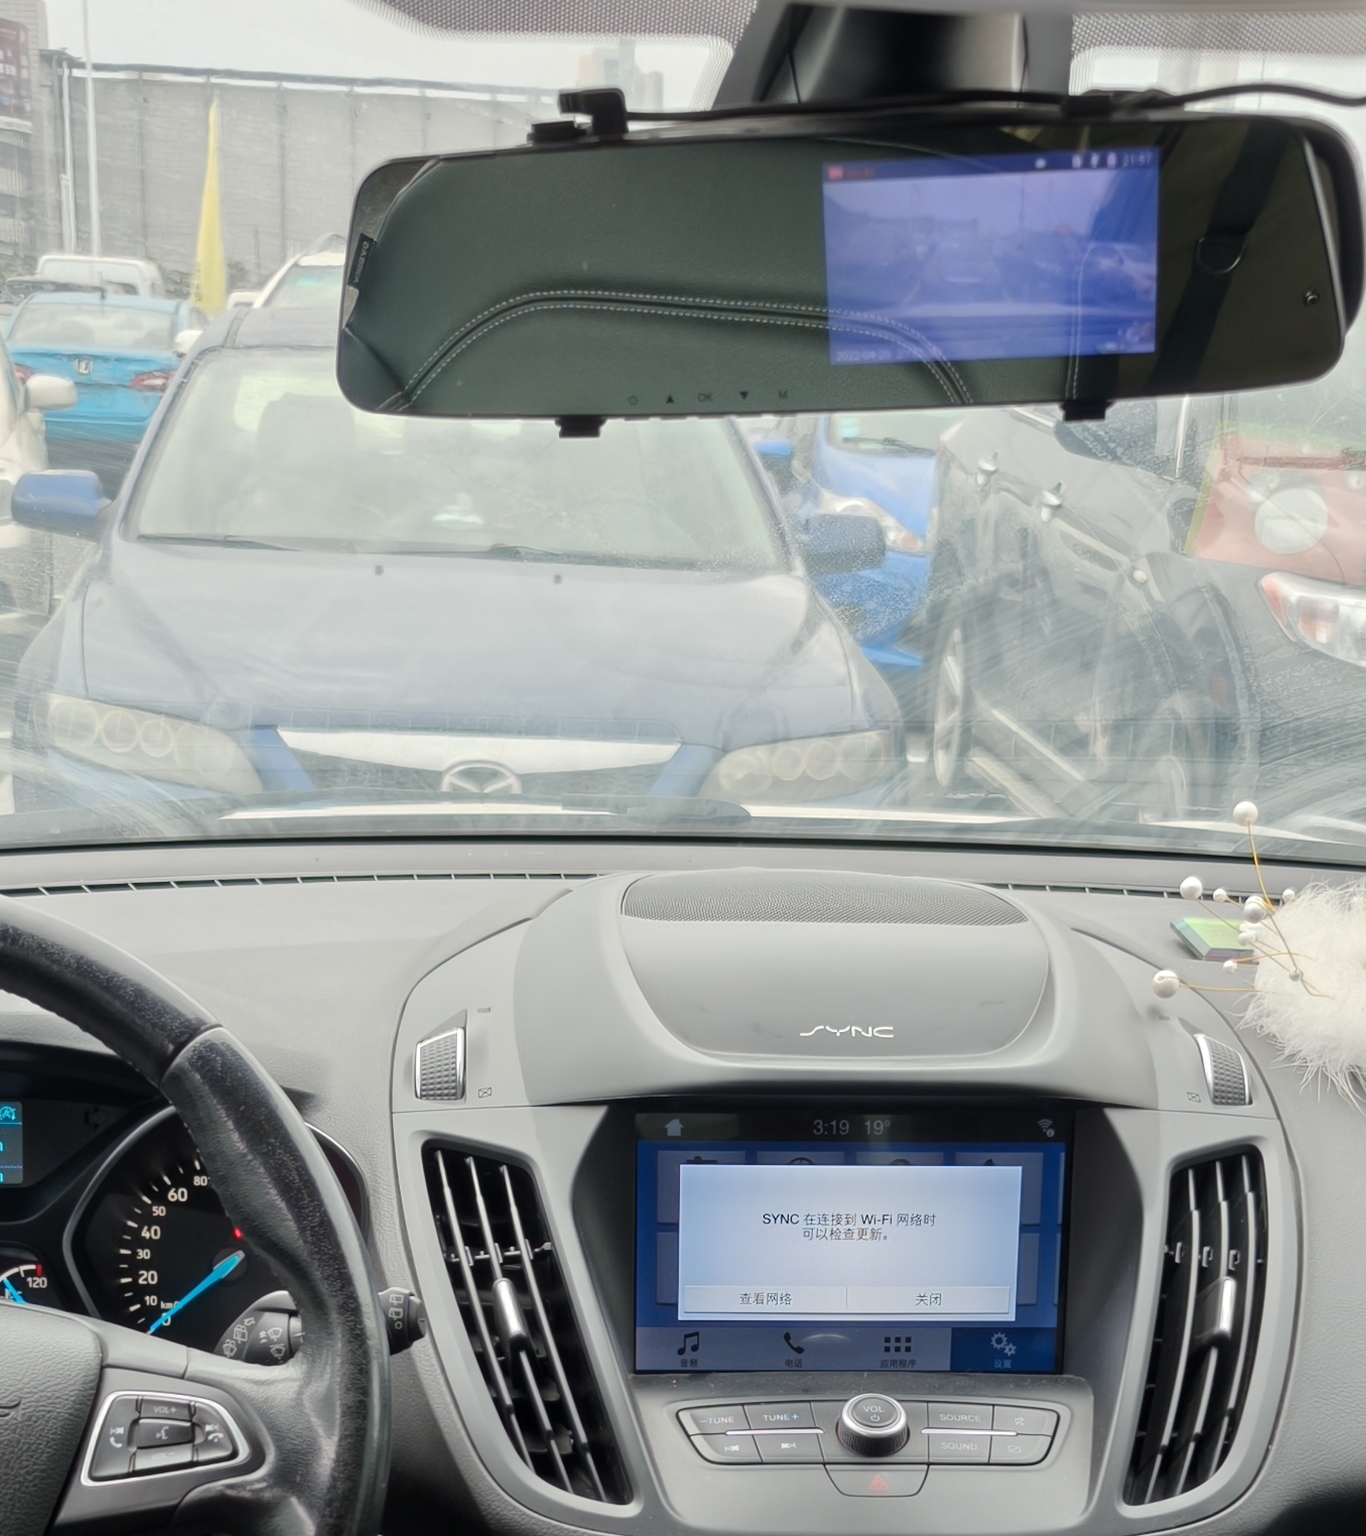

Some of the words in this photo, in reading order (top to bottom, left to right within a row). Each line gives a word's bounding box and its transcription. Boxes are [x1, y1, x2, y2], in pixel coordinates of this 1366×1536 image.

[697, 392, 713, 403] OK
[799, 1025, 894, 1038] SYNC
[813, 1119, 850, 1136] 3:19
[864, 1119, 891, 1136] 19°
[167, 1187, 188, 1202] 60
[152, 1206, 166, 1217] 50
[762, 1213, 800, 1225] SYNC
[803, 1212, 857, 1227] 在连接到
[861, 1213, 893, 1225] Wi-Fi
[896, 1212, 936, 1227] 网络时
[141, 1226, 161, 1240] 40
[802, 1227, 888, 1241] 可以检查更新。
[136, 1249, 151, 1260] 30
[27, 1277, 47, 1288] 120
[138, 1270, 158, 1285] 20
[144, 1295, 158, 1306] 10
[739, 1292, 792, 1306] 查看网络
[915, 1292, 942, 1306] 关闭
[785, 1358, 803, 1368] 电话
[879, 1358, 917, 1369] 应用程序
[993, 1358, 1012, 1369] 设置
[862, 1405, 884, 1413] VOL
[939, 1413, 981, 1423] SOURCE
[940, 1442, 978, 1451] SOUND
